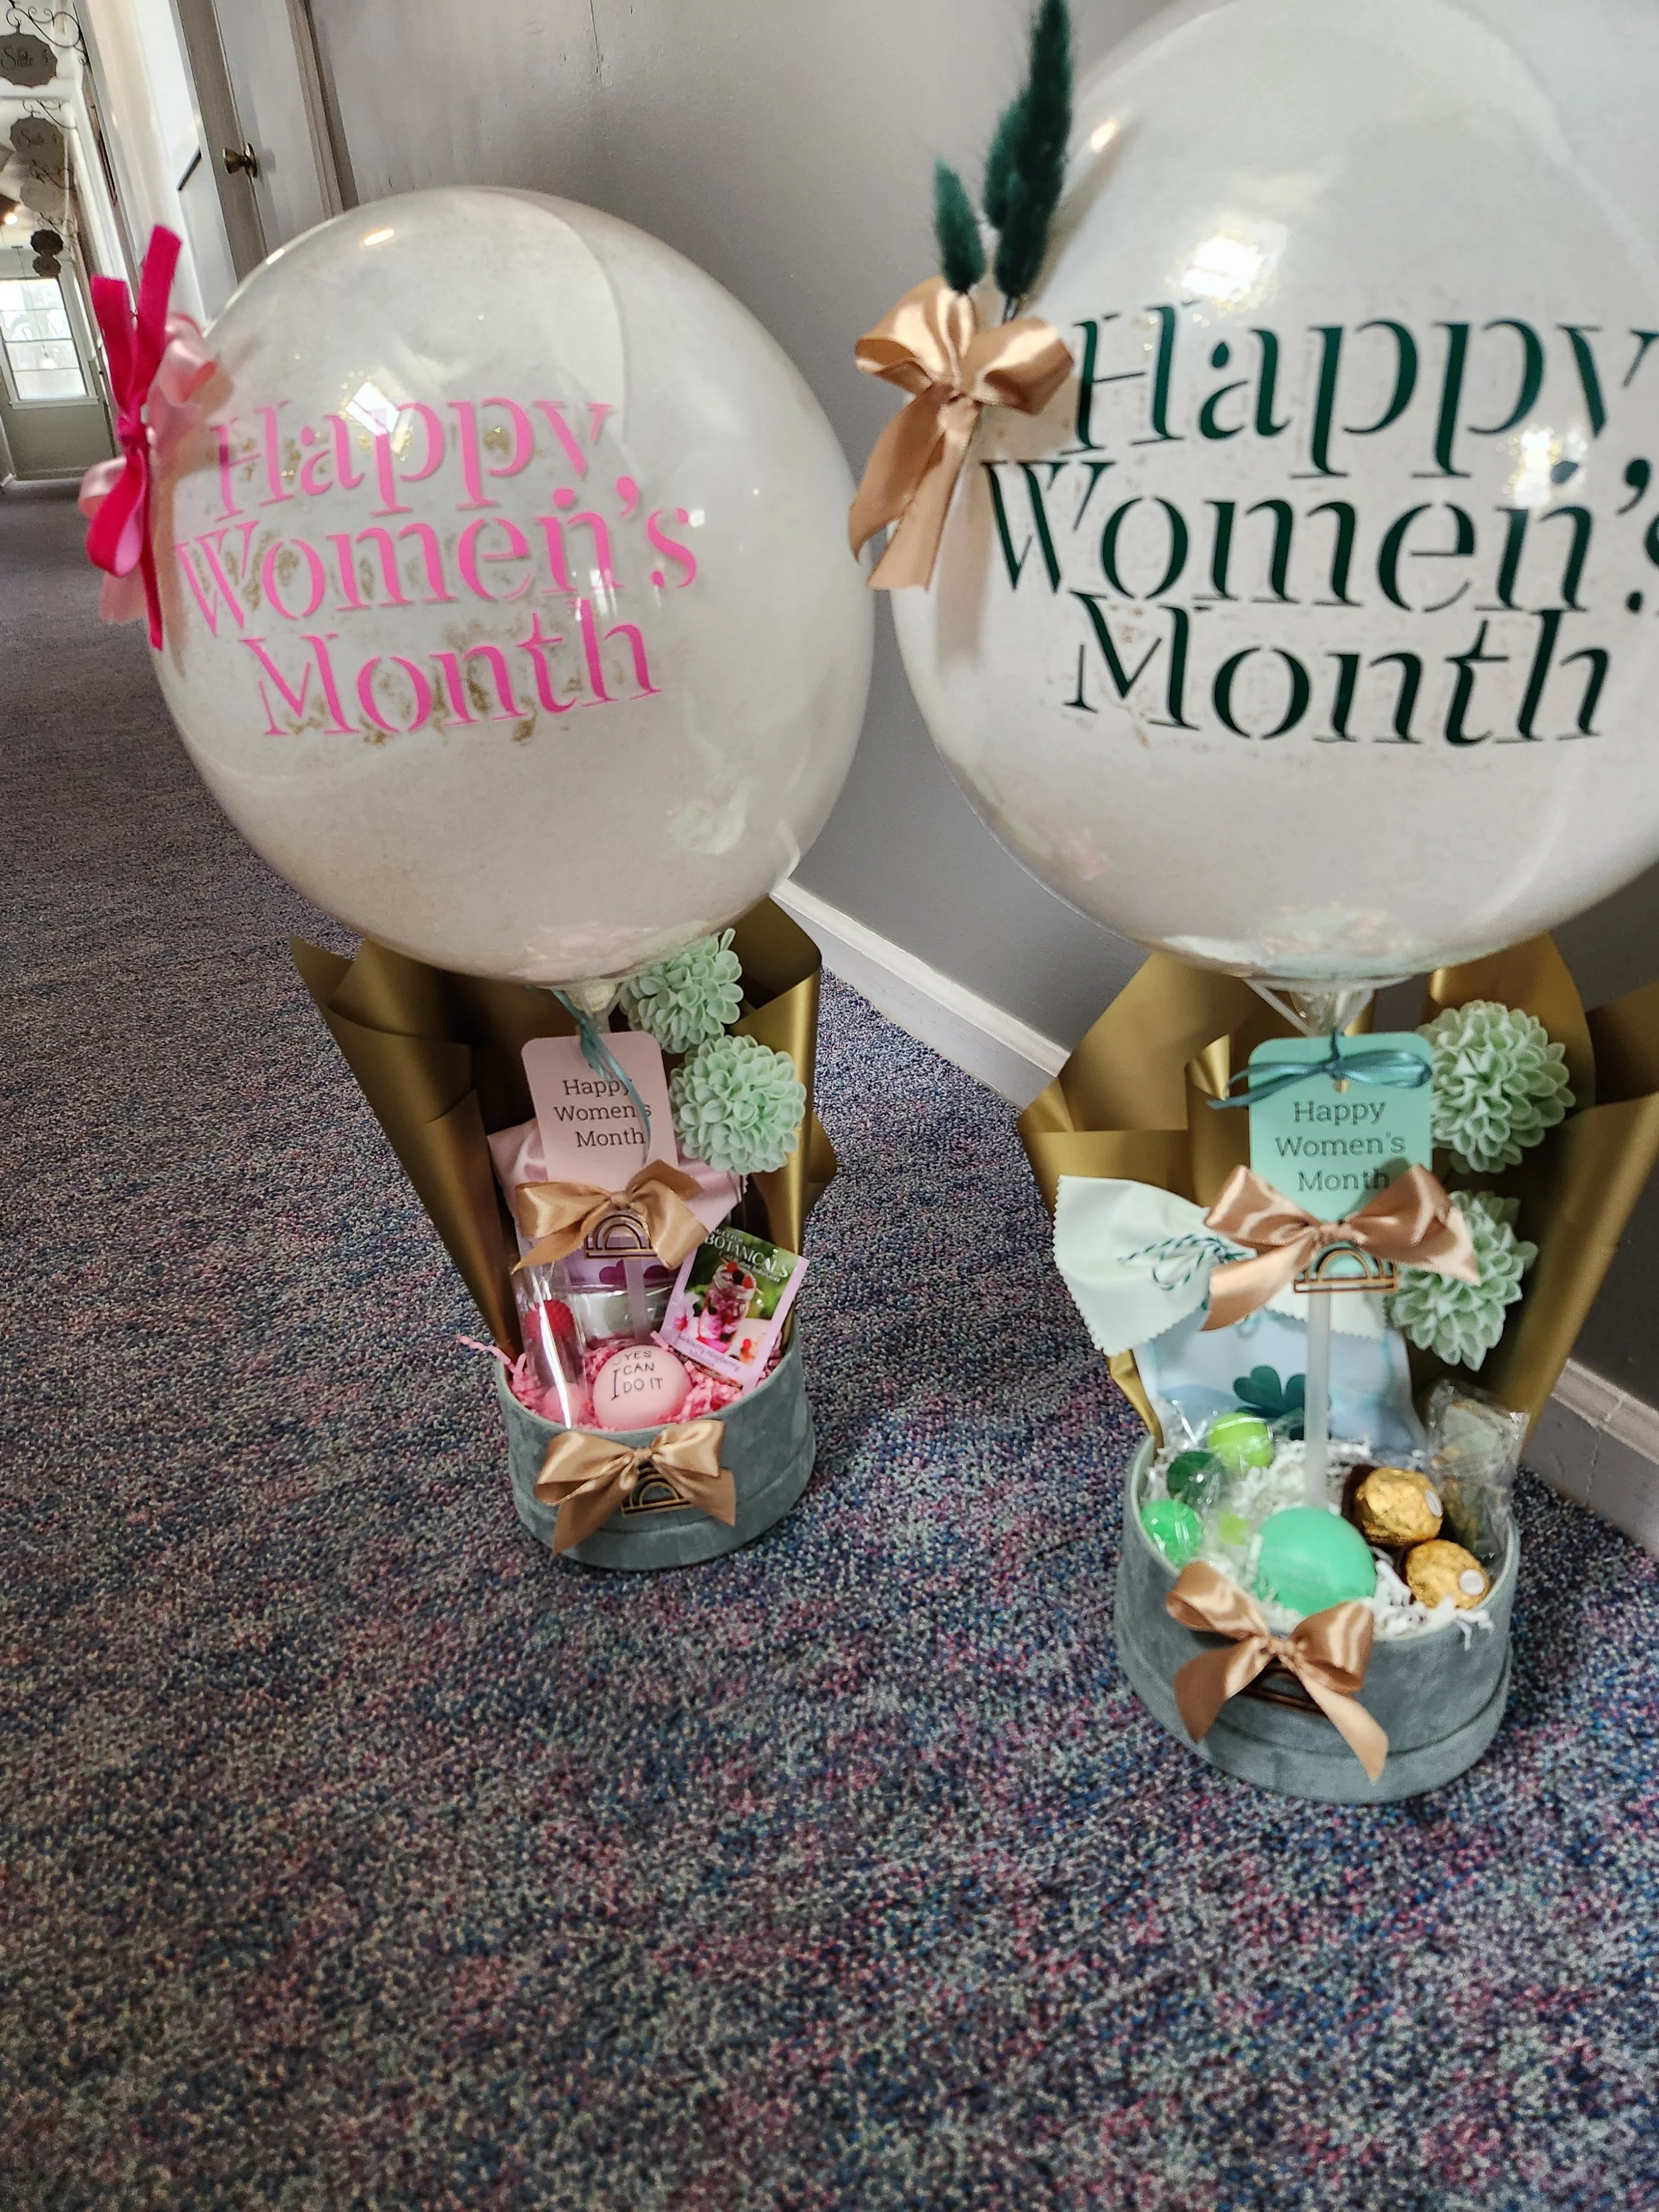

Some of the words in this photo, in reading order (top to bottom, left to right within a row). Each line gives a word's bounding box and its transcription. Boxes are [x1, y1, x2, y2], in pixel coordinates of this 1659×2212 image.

[1060, 301, 1659, 485] Happy
[209, 397, 613, 522] Happy
[175, 476, 698, 636] Women's
[240, 599, 664, 737] Month
[1062, 591, 1612, 747] Month
[553, 1104, 652, 1122] Womens
[1293, 1100, 1386, 1126] Happy
[575, 1127, 646, 1147] Month
[1275, 1132, 1406, 1158] Women's
[1297, 1167, 1390, 1192] Month
[705, 1232, 789, 1278] BOTANICALS
[624, 1350, 652, 1361] YES
[624, 1362, 655, 1375] CAN
[624, 1378, 644, 1393] DO
[650, 1377, 663, 1389] IT
